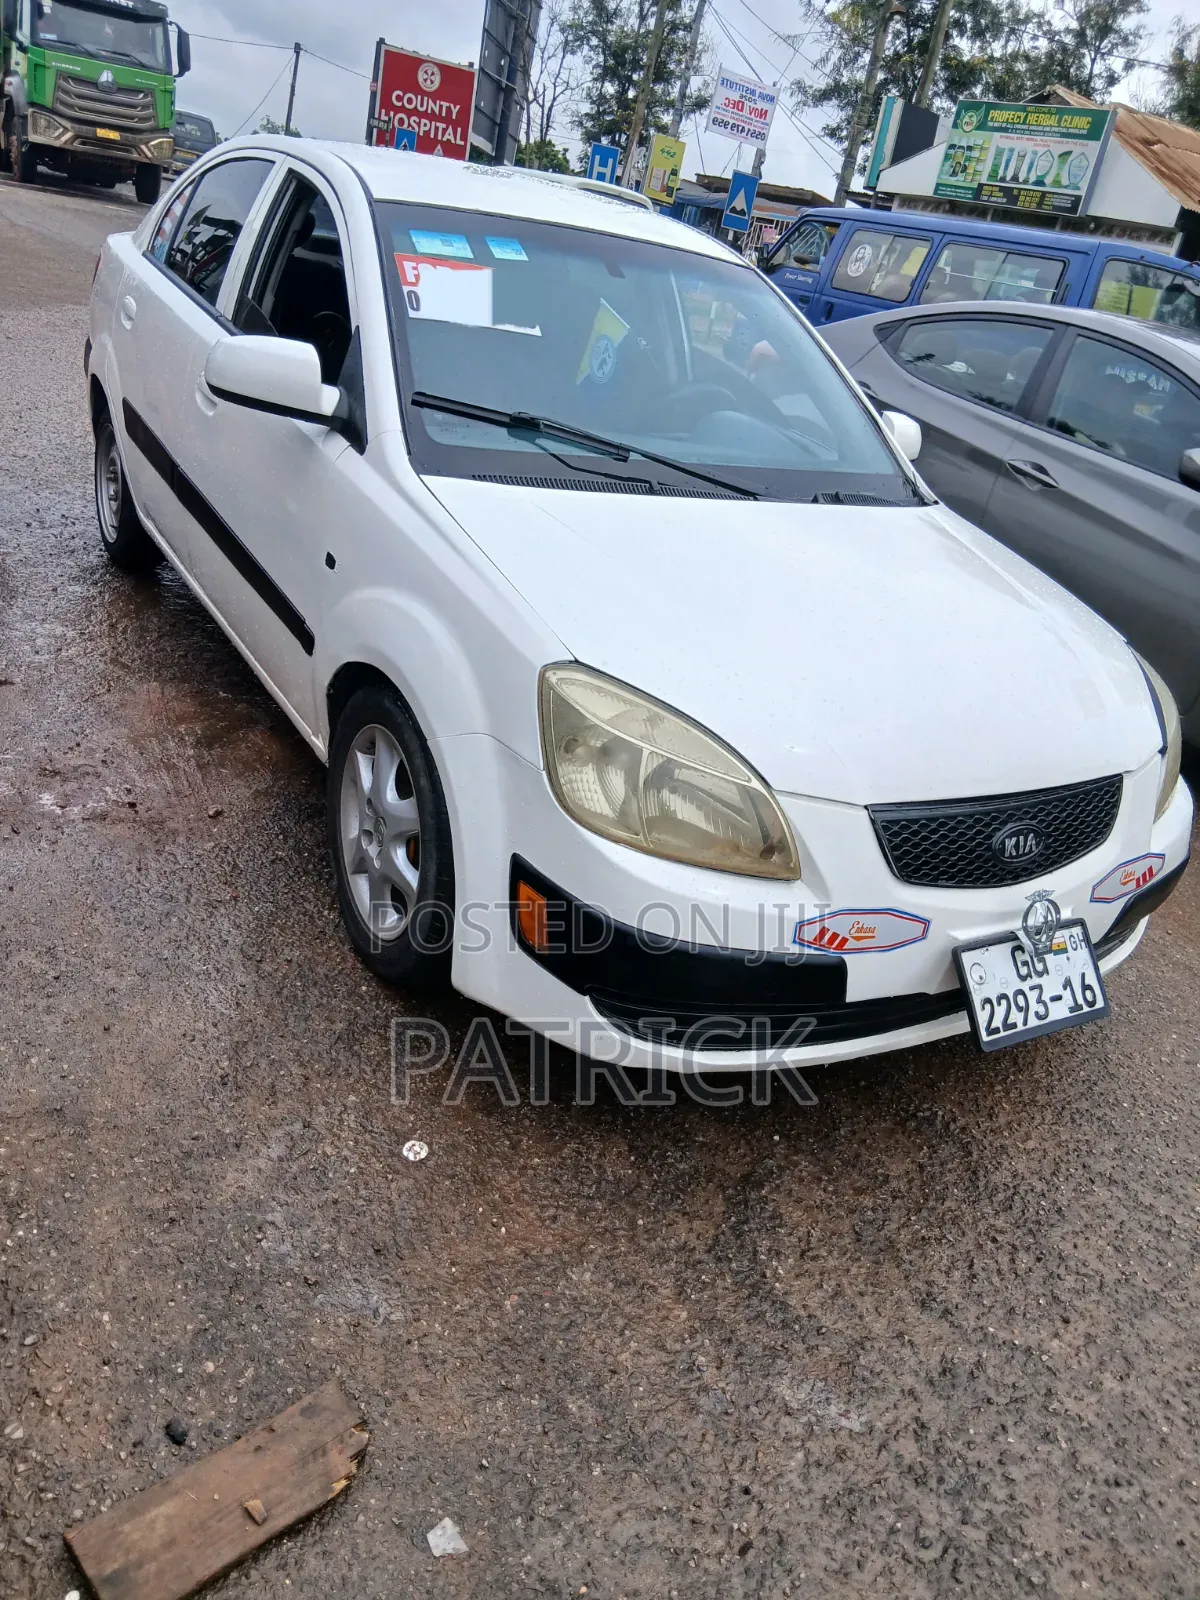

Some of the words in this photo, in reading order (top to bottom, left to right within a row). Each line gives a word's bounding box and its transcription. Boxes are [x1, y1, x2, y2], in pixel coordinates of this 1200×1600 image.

[392, 90, 460, 119] COUNTY
[381, 109, 465, 145] HOSPITAL
[988, 110, 1026, 123] PROFECY
[1026, 113, 1059, 127] HERBAL
[1060, 115, 1092, 129] CLINIC
[592, 155, 613, 183] H
[1004, 833, 1038, 857] KIA
[1010, 945, 1049, 982] GG
[1068, 931, 1088, 951] GH
[980, 972, 1098, 1037] 2293-16
